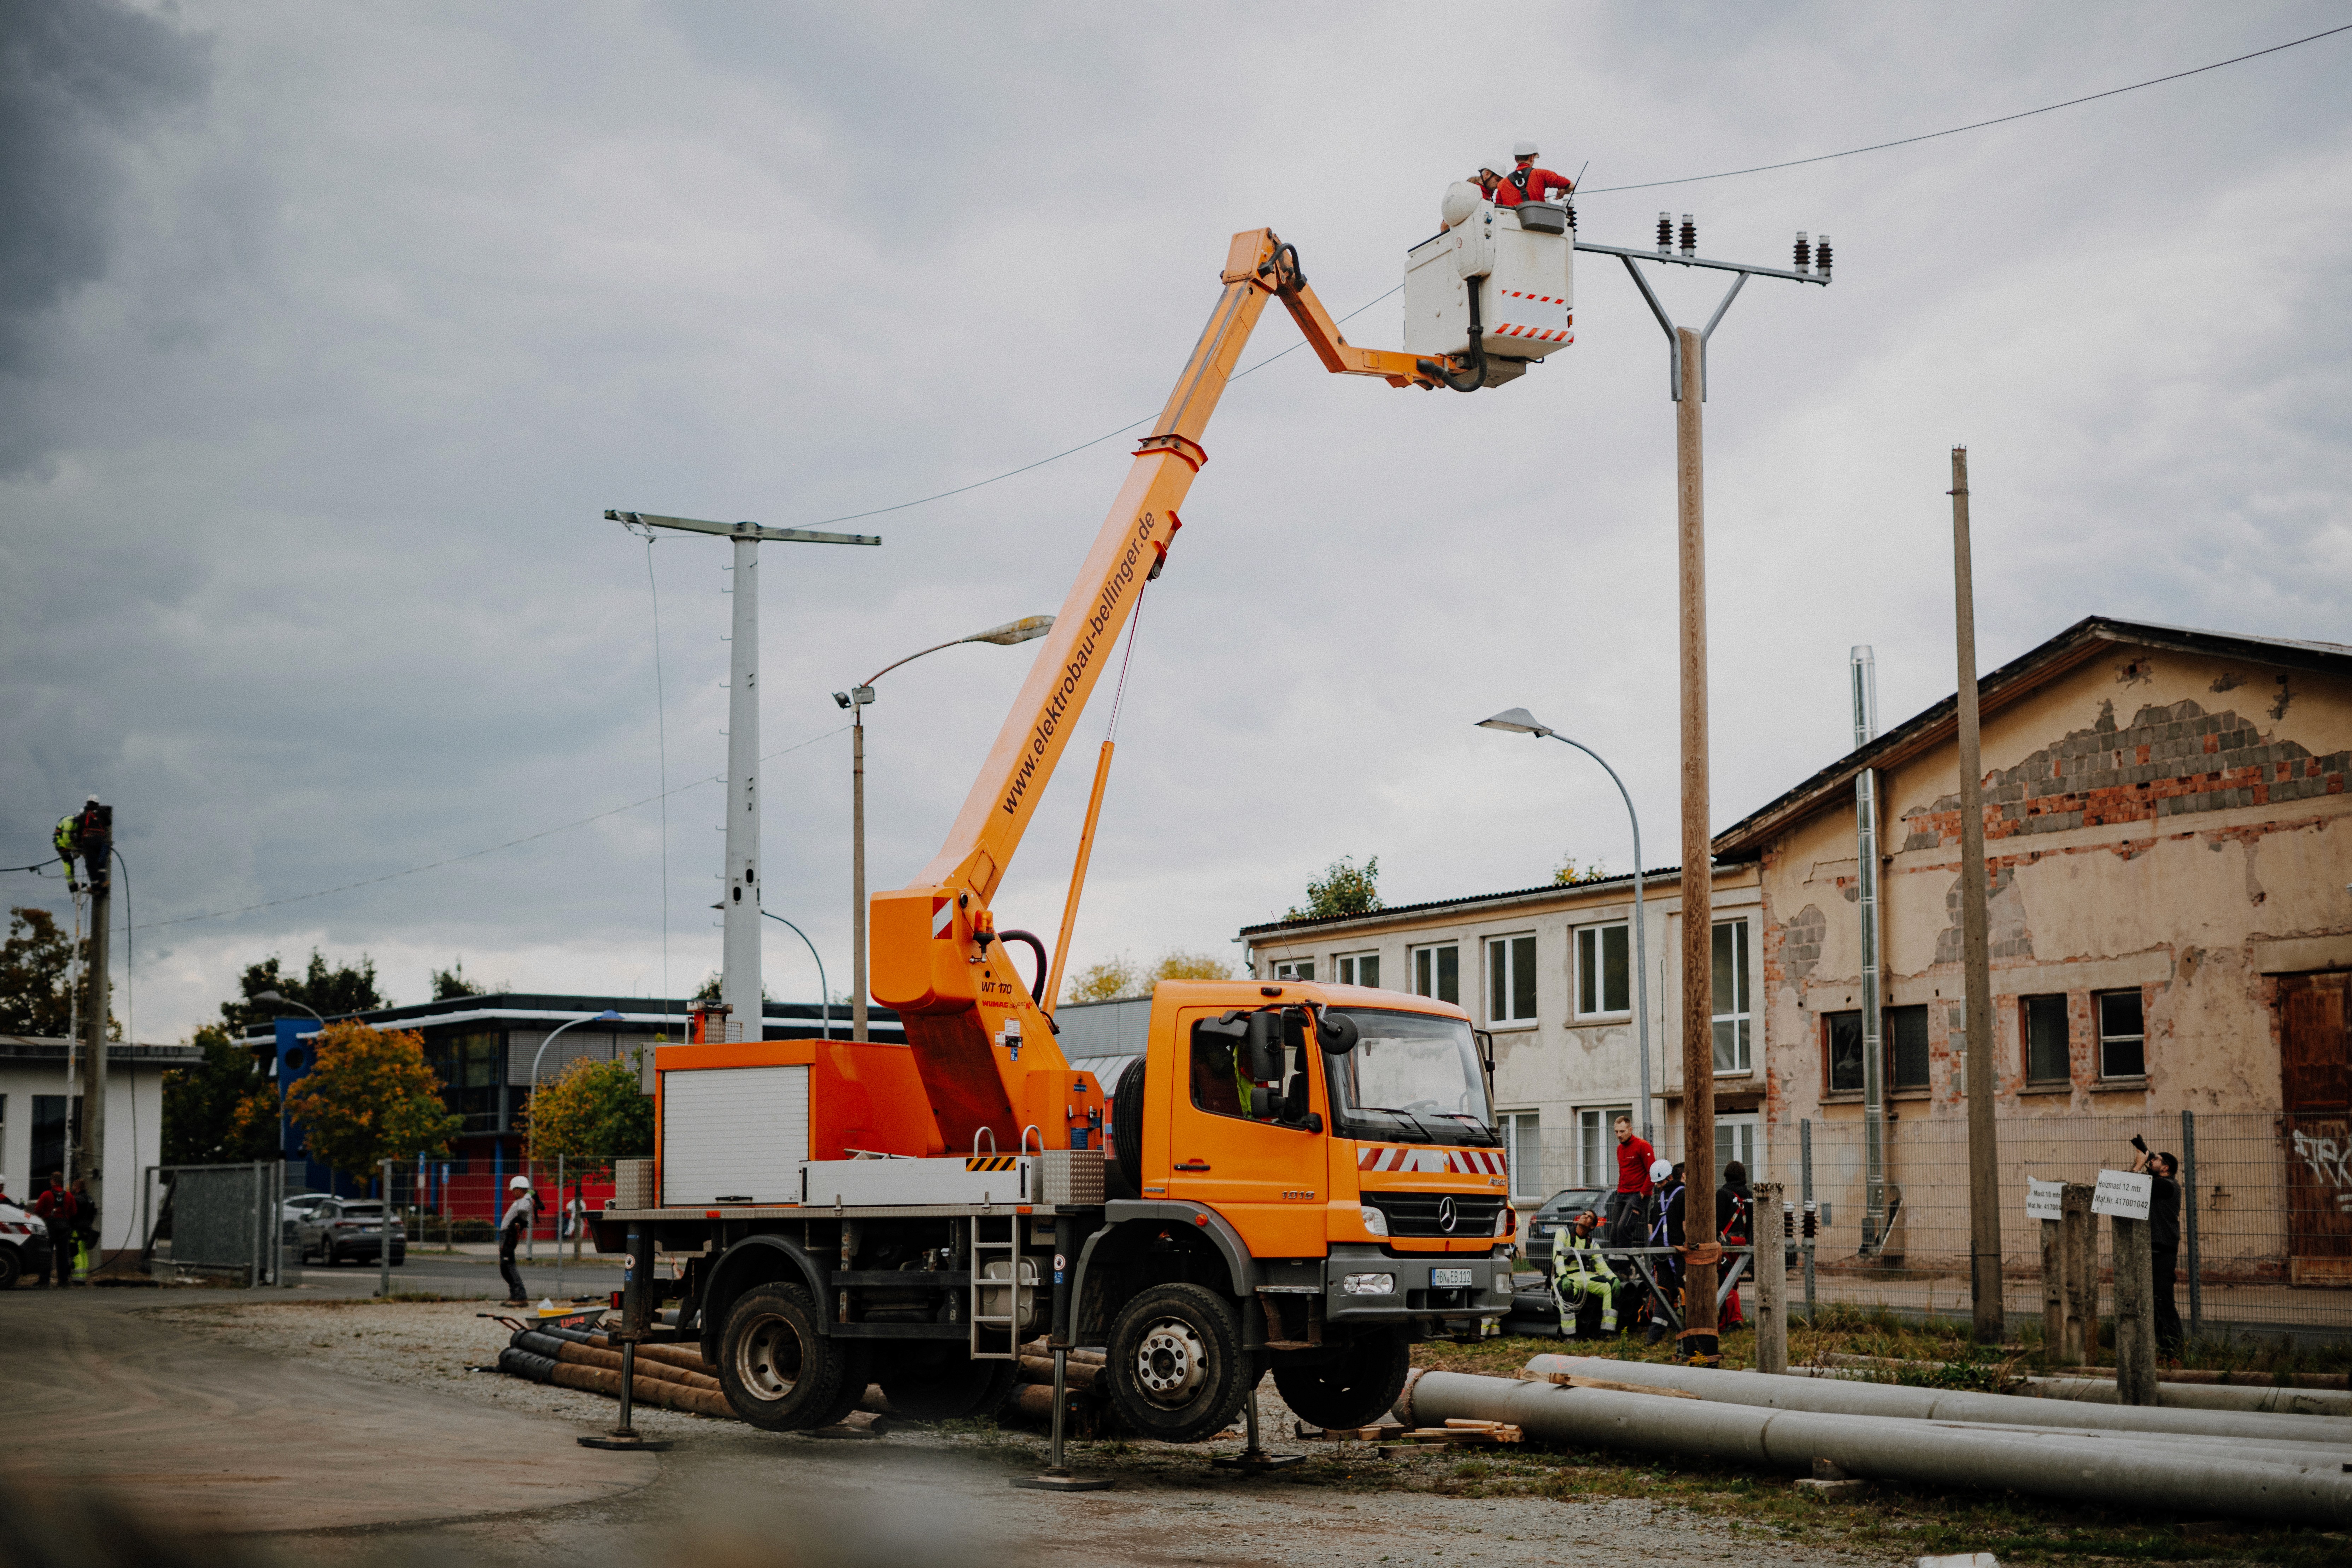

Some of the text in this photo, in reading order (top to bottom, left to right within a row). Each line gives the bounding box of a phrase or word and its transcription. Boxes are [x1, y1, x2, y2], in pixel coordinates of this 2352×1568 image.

[1003, 511, 1155, 815] www.elektrobau-bellinger.de
[981, 981, 1012, 994] WT 170
[2098, 1180, 2121, 1190] Holzmast
[1281, 1191, 1315, 1199] 1018
[2115, 1198, 2148, 1209] 417001042
[1436, 1270, 1471, 1283] HBN EB 112
